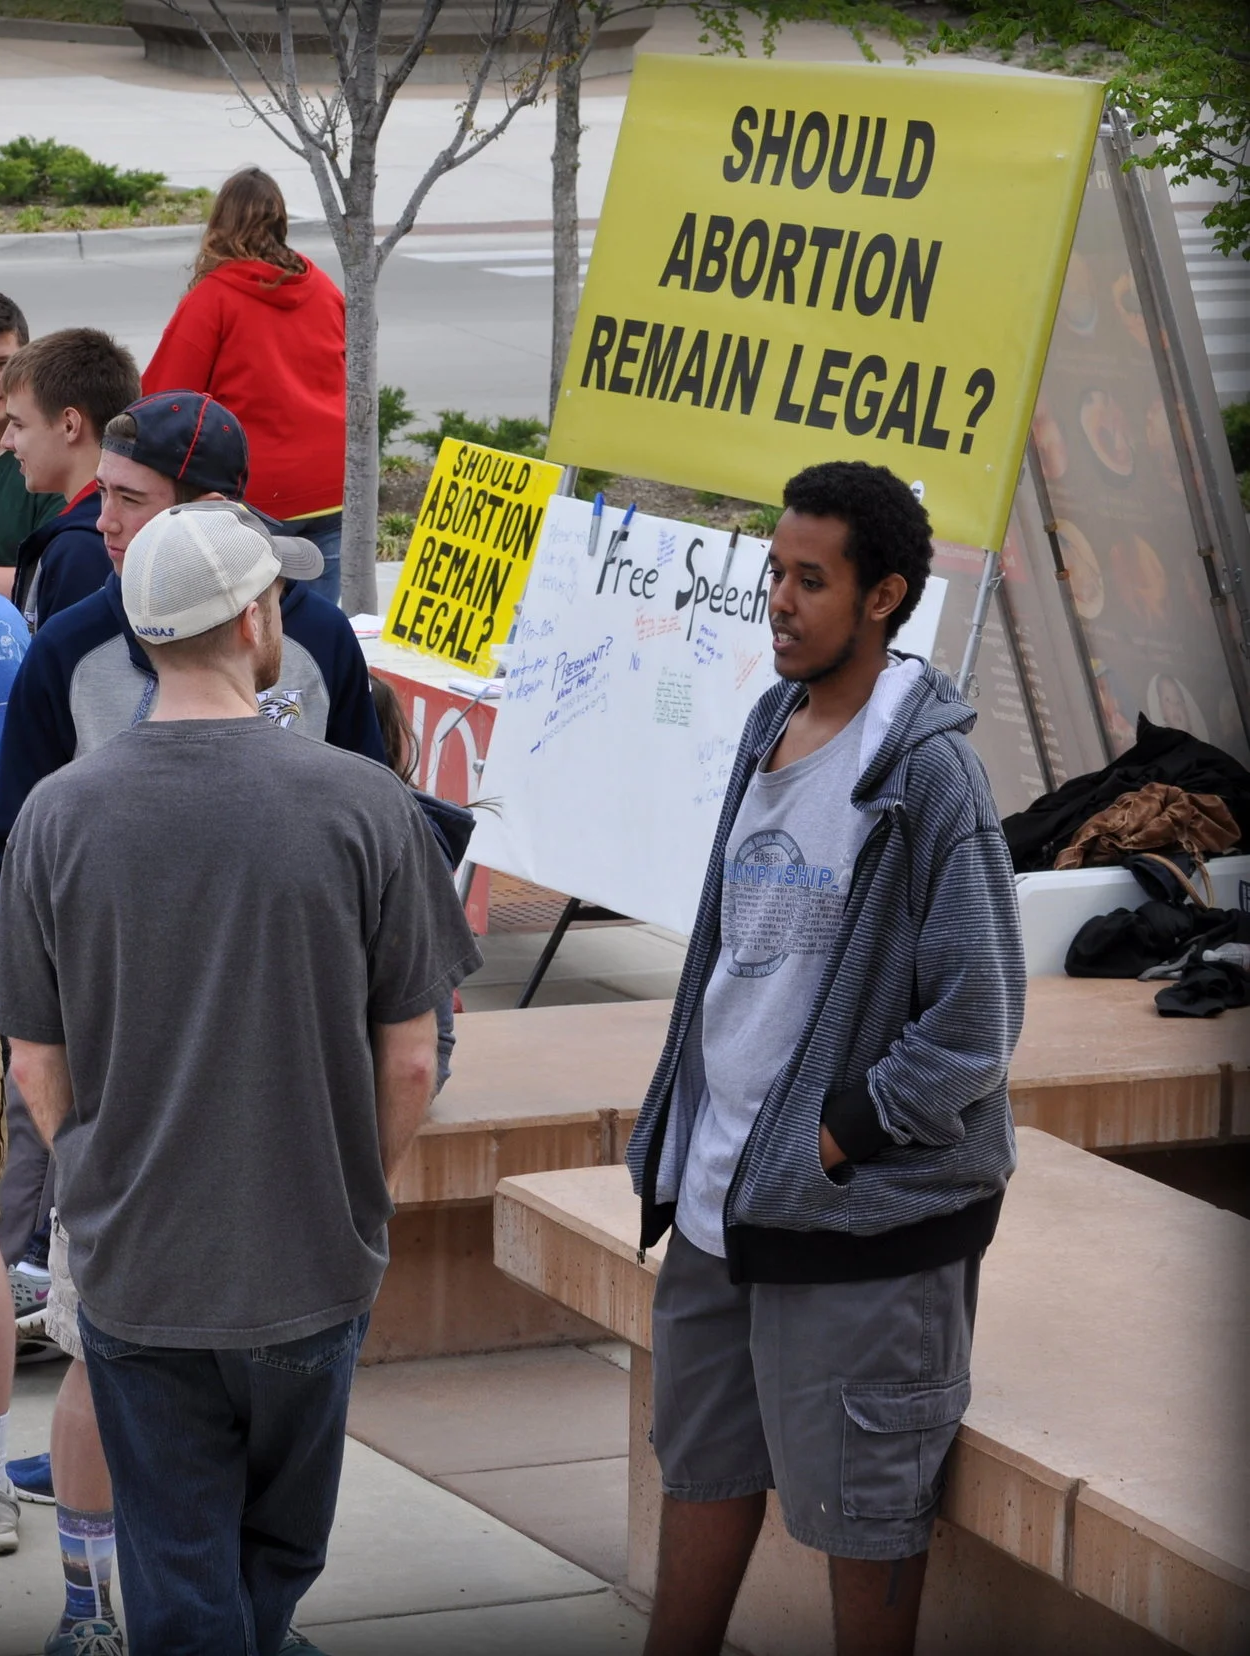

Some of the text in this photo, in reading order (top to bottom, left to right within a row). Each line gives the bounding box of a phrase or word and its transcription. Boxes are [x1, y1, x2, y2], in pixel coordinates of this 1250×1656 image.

[722, 105, 935, 199] SHOULD
[658, 212, 942, 323] ABORTION
[579, 314, 996, 455] REMAIN LEGAL?
[452, 445, 531, 494] SHOULD
[420, 476, 544, 561] ABORTION
[411, 536, 513, 616] REMAIN
[596, 530, 659, 600] Free
[675, 537, 769, 641] Speech
[392, 590, 494, 665] LEGAL?
[551, 636, 614, 691] PREGNANT?
[754, 852, 784, 863] BASEBLL
